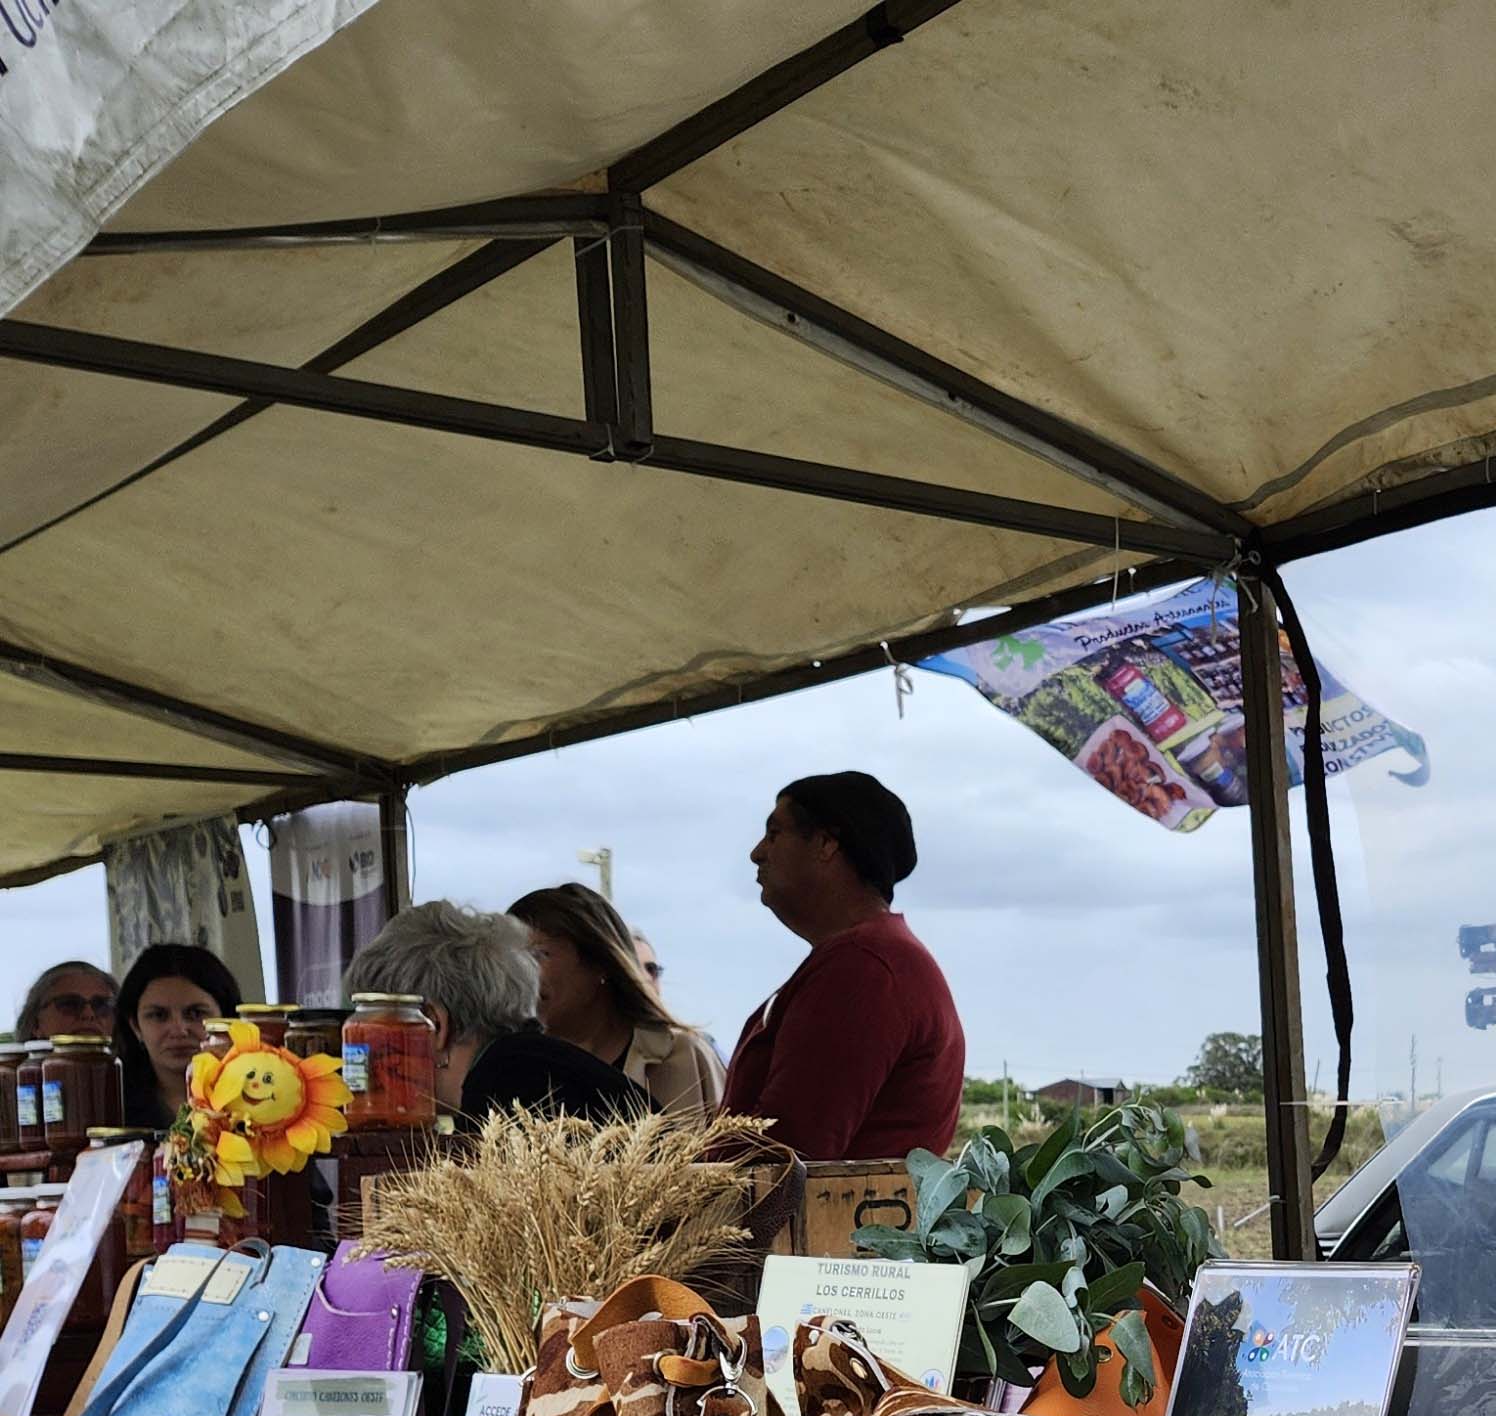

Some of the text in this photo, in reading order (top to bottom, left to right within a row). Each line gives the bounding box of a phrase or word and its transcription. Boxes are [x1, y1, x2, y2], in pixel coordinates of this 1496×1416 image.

[818, 1262, 911, 1279] TURISMO RURAL
[816, 1285, 905, 1301] LOS CERRILLOS
[1271, 1333, 1321, 1361] ATC
